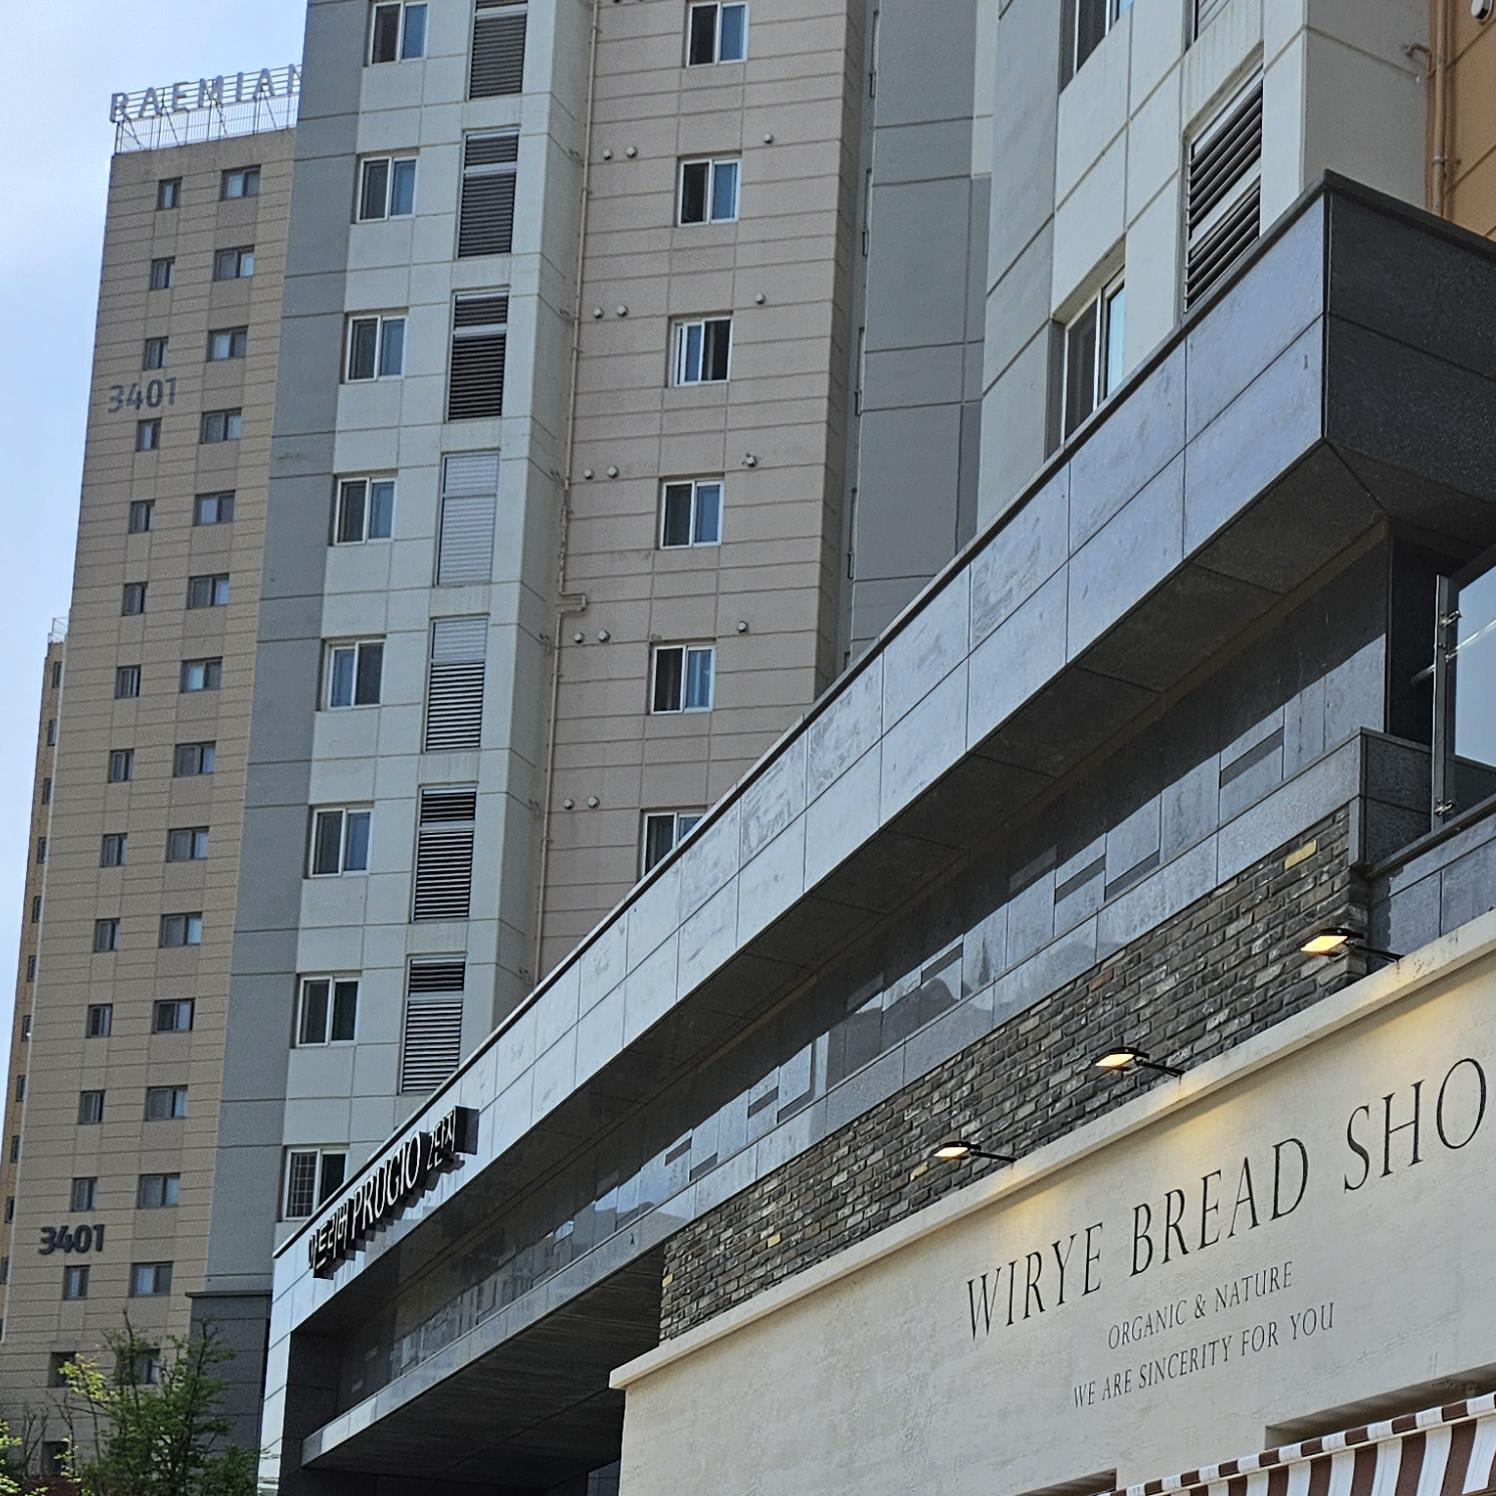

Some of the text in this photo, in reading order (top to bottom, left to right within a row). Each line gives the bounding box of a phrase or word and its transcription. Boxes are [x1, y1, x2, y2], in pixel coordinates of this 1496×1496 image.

[107, 377, 177, 414] 3401
[351, 1131, 421, 1240] PRUGIO
[427, 1106, 456, 1171] 2단지
[38, 1223, 105, 1256] 3401
[965, 1221, 1103, 1342] WIRYE
[1129, 1136, 1310, 1279] BREAD
[1108, 1261, 1293, 1350] ORGANIC & NATURE
[1073, 1302, 1335, 1408] WE ARE SINCERITY FOR YOU
